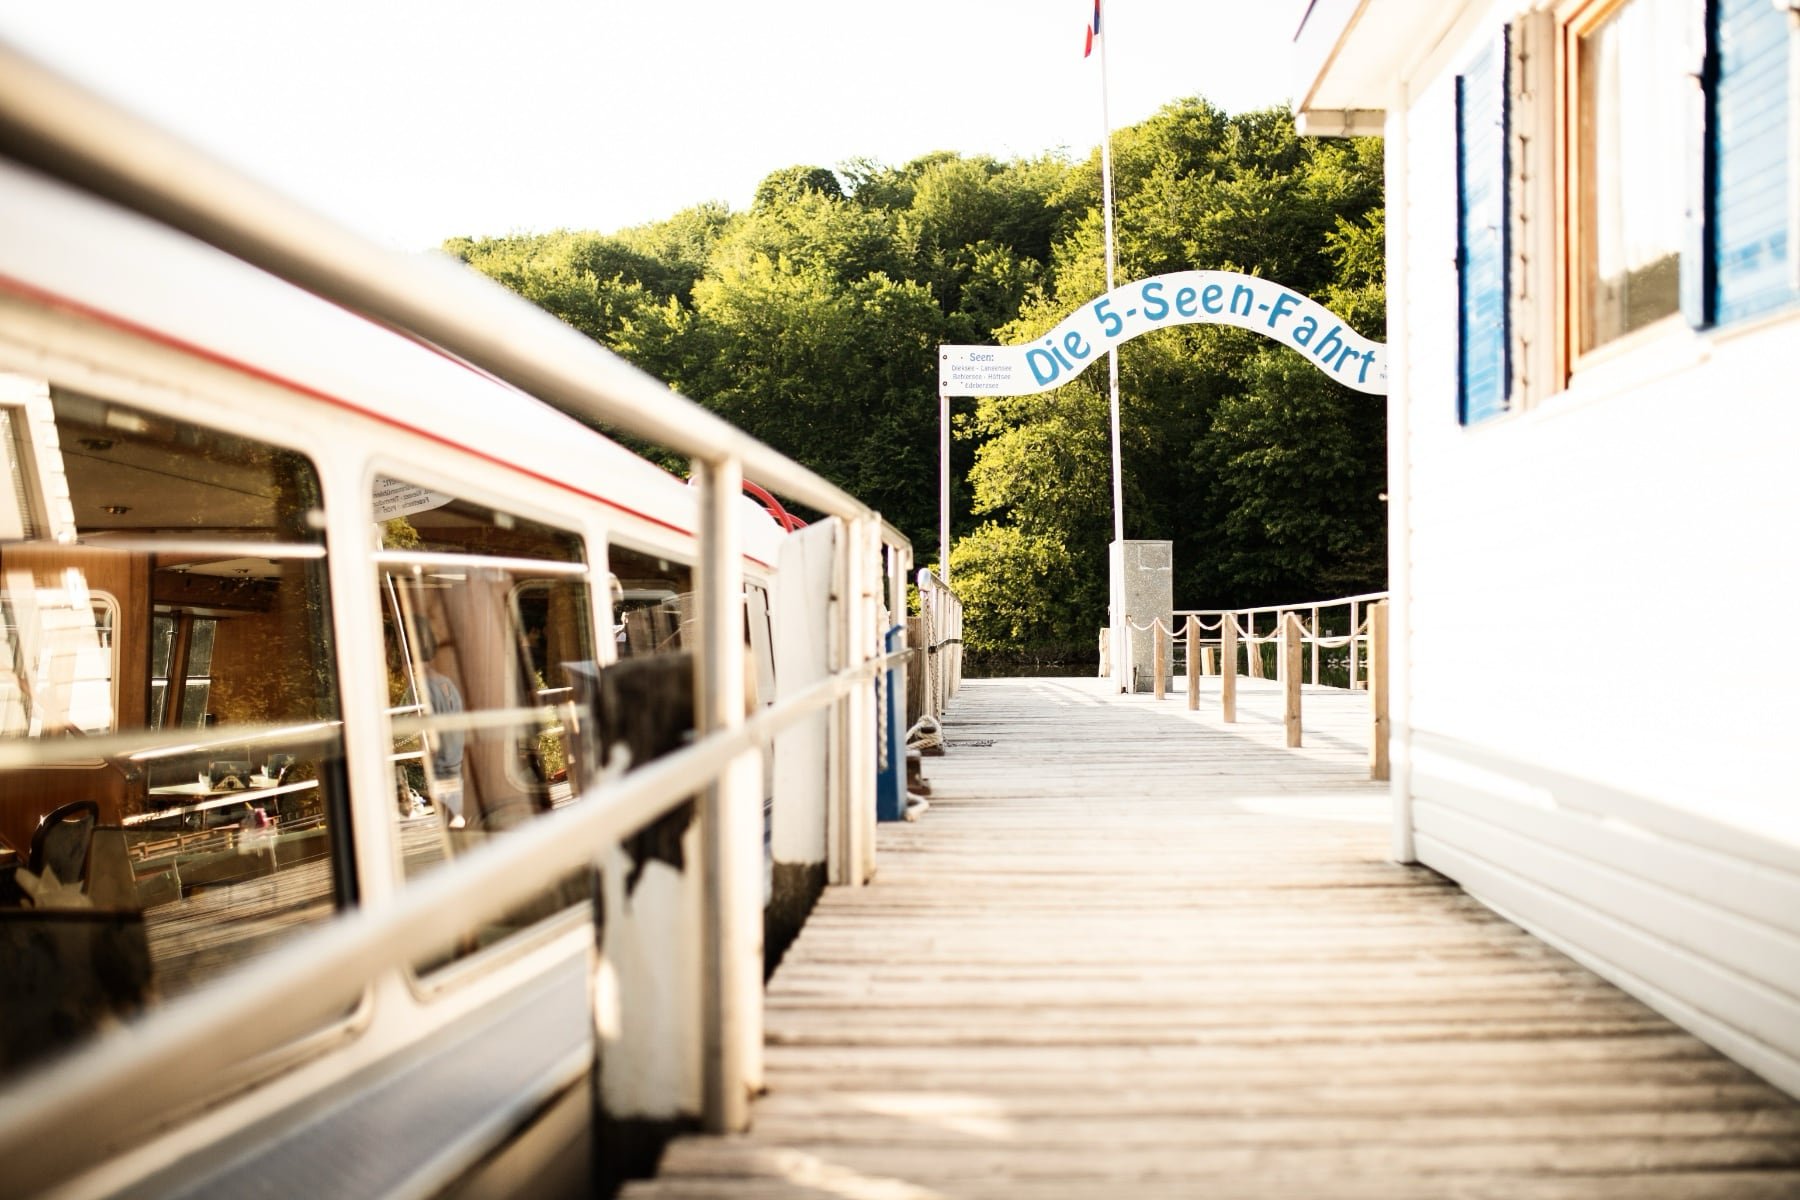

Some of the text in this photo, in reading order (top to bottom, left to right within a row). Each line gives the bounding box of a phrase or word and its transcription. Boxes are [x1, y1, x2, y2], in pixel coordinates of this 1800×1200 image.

[969, 352, 995, 362] Seen:
[1024, 281, 1376, 387] Die 5-Seen-Fahrt
